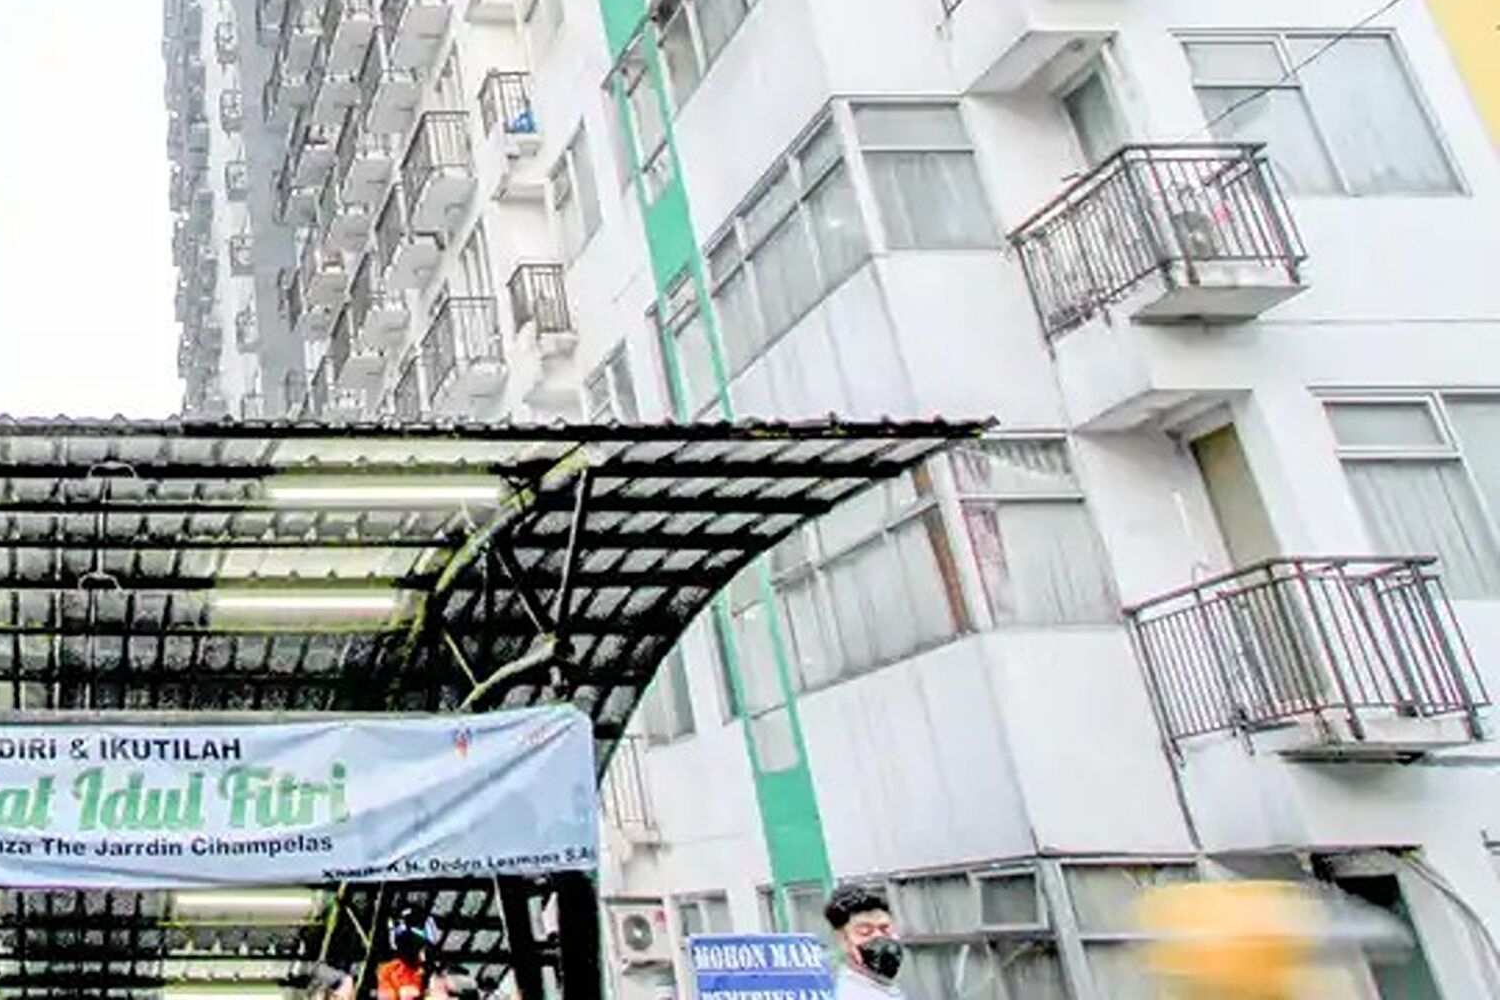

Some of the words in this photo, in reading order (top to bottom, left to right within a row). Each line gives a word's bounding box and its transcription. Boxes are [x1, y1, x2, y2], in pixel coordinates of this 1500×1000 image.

[69, 738, 89, 760] &
[100, 737, 241, 760] IKUTILAH
[72, 766, 206, 831] Idul
[218, 762, 350, 829] Fitri
[41, 838, 87, 856] The
[191, 834, 334, 858] Cihampelas
[693, 942, 768, 970] MOHON
